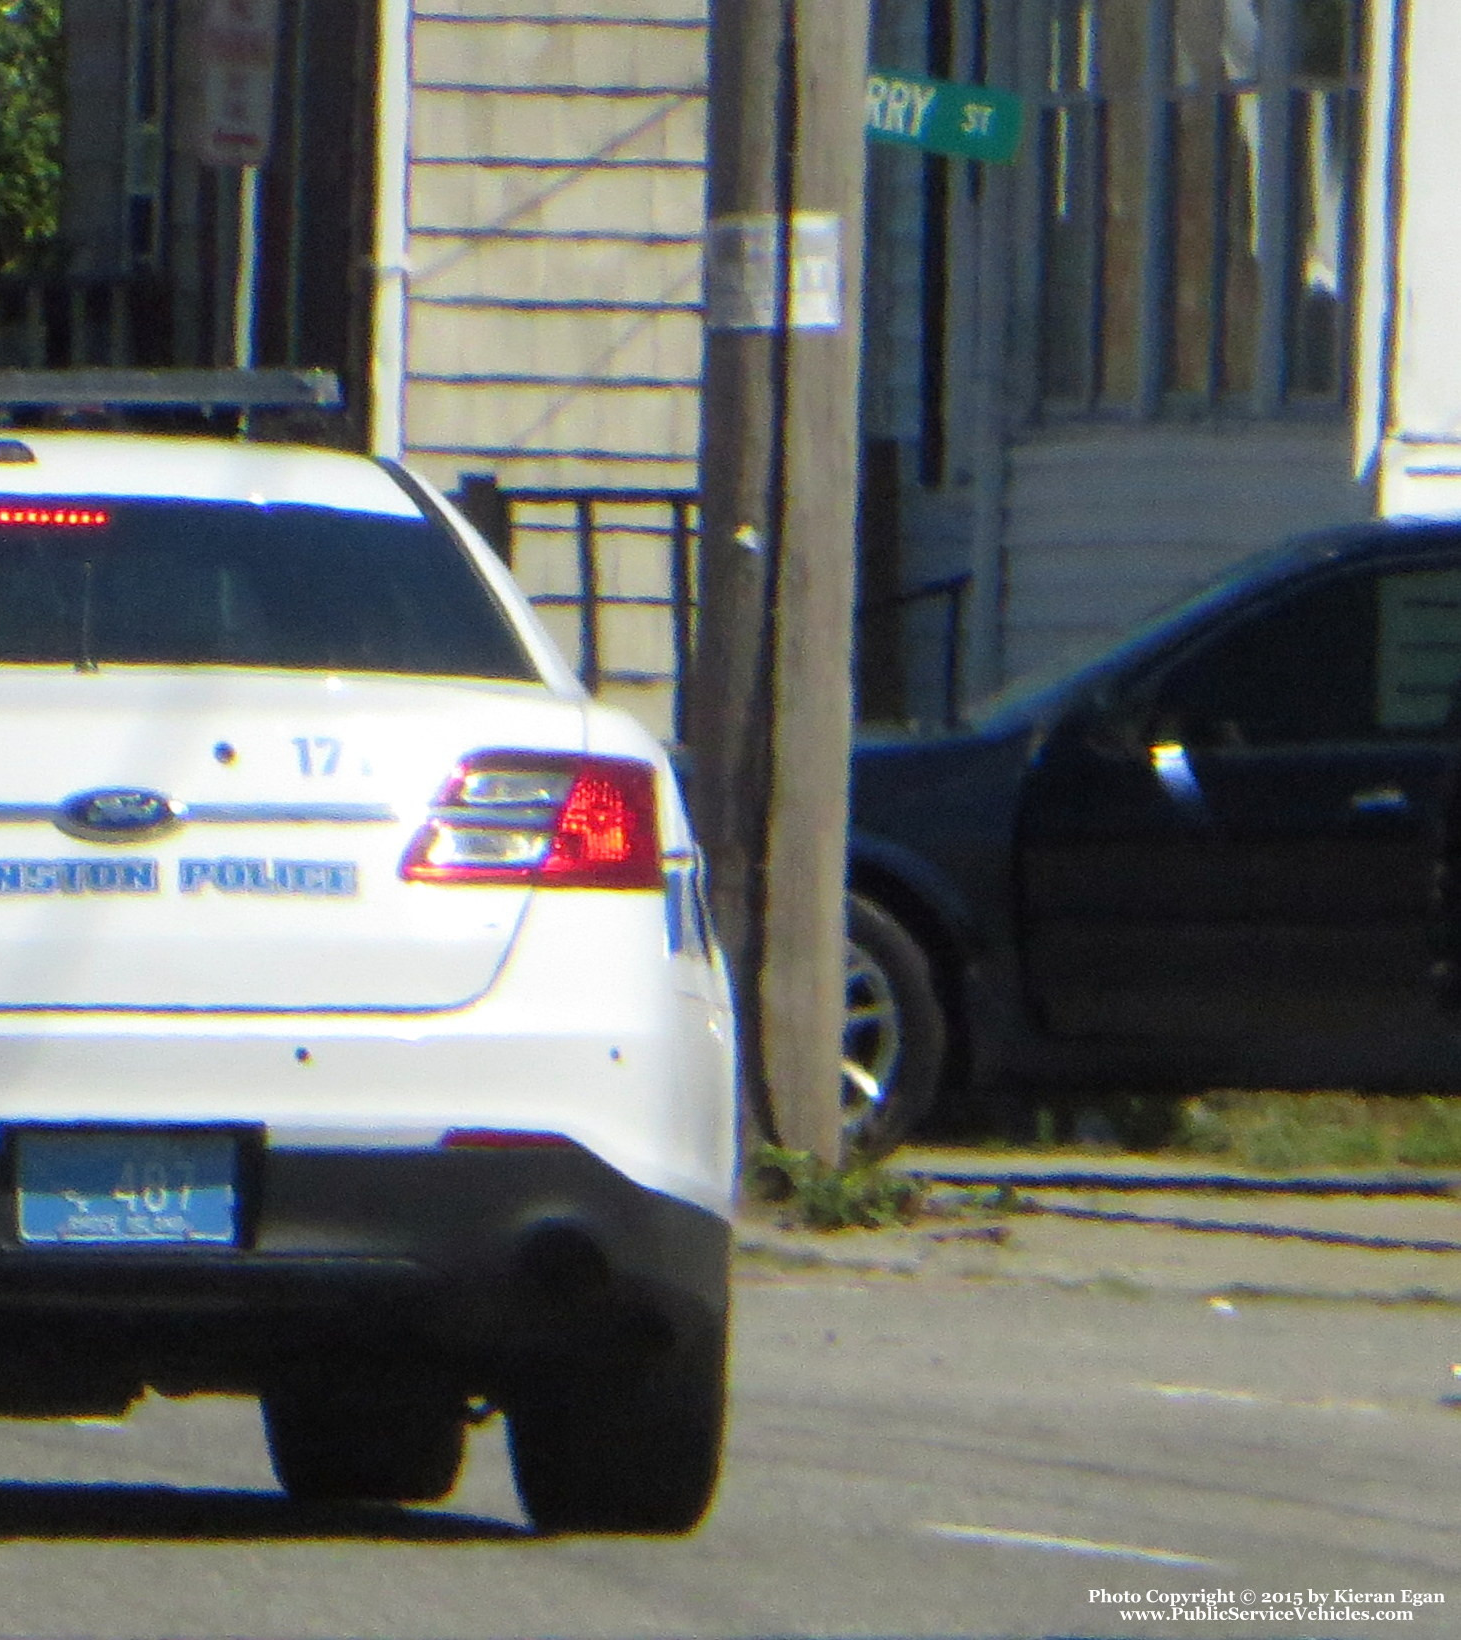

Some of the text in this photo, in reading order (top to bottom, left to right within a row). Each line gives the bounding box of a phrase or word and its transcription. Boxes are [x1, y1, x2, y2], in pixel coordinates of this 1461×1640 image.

[961, 104, 994, 135] ST
[291, 736, 372, 777] 17
[179, 858, 358, 896] POLICE
